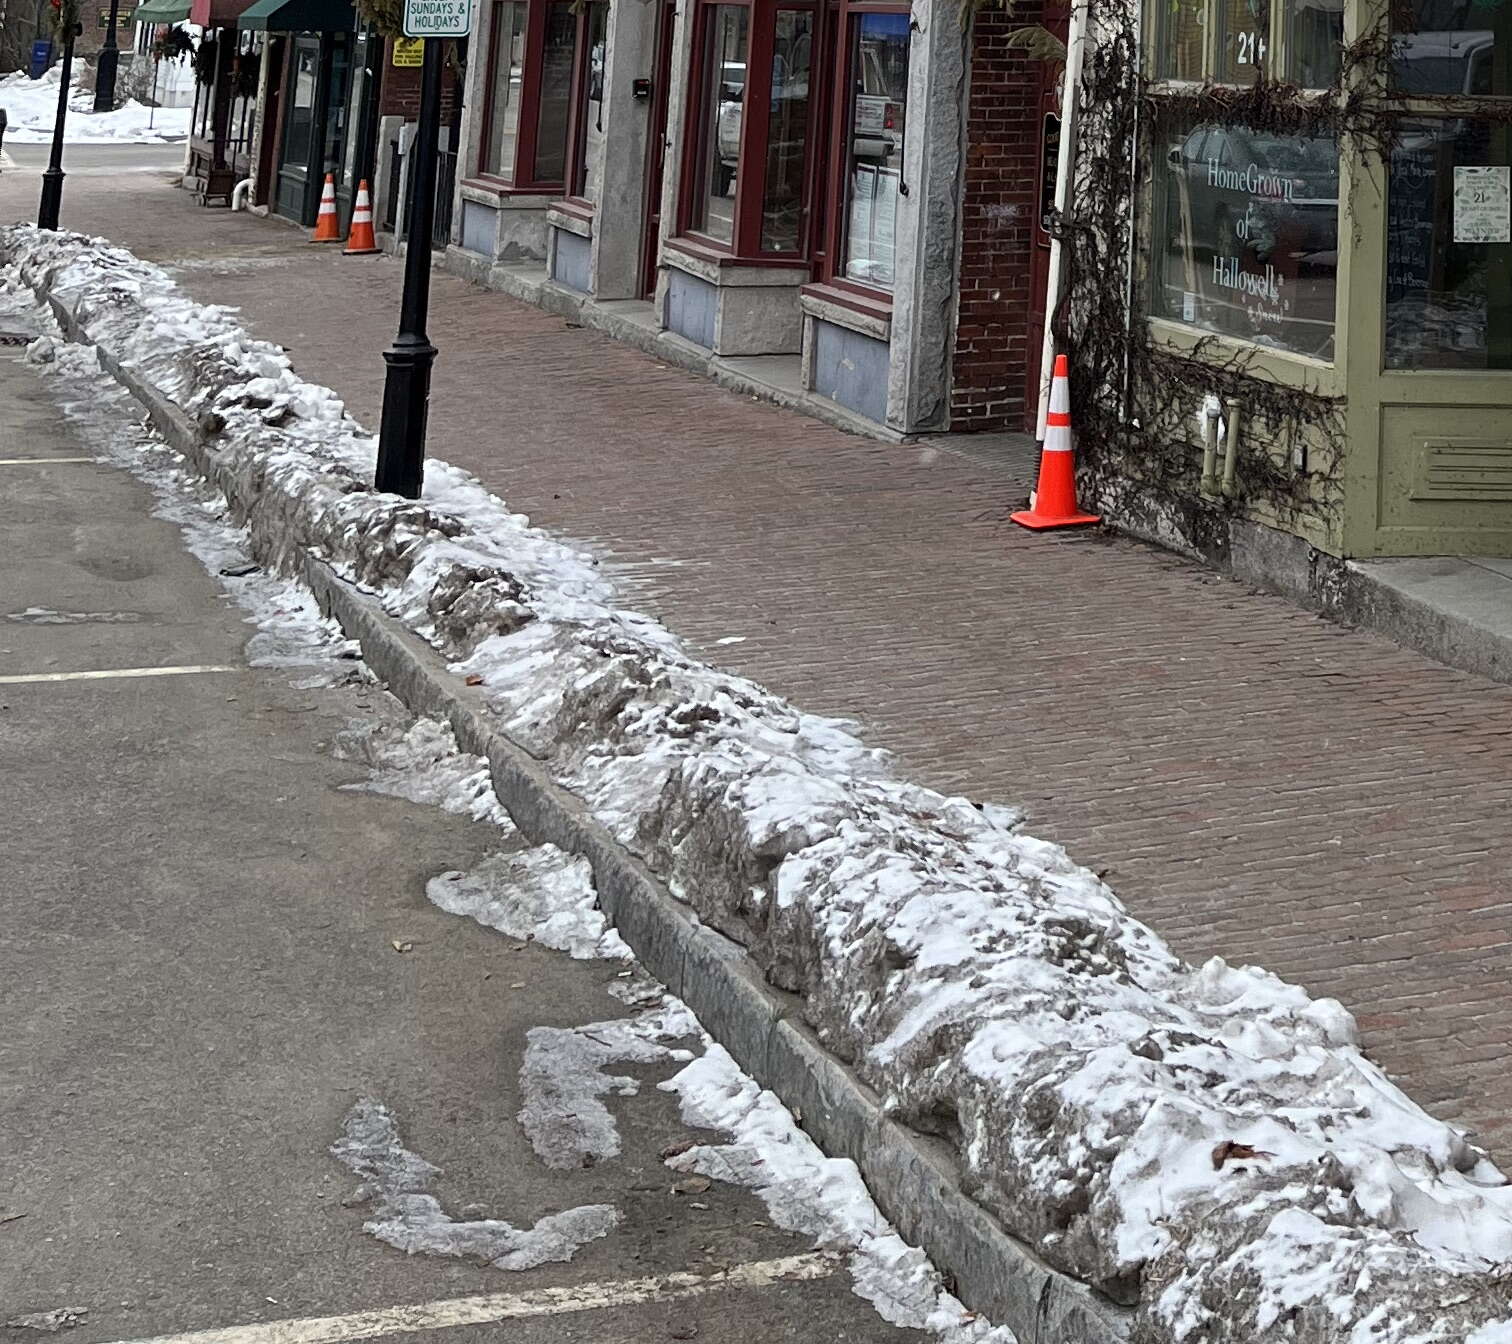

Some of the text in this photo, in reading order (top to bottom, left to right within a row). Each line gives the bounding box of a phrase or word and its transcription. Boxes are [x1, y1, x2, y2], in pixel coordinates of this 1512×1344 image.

[411, 2, 465, 15] SUNDAYS &
[414, 15, 460, 28] HOLIDAYS
[1207, 157, 1294, 200] HomeGrown
[1236, 208, 1253, 241] of
[1212, 255, 1275, 298] Hallowell
